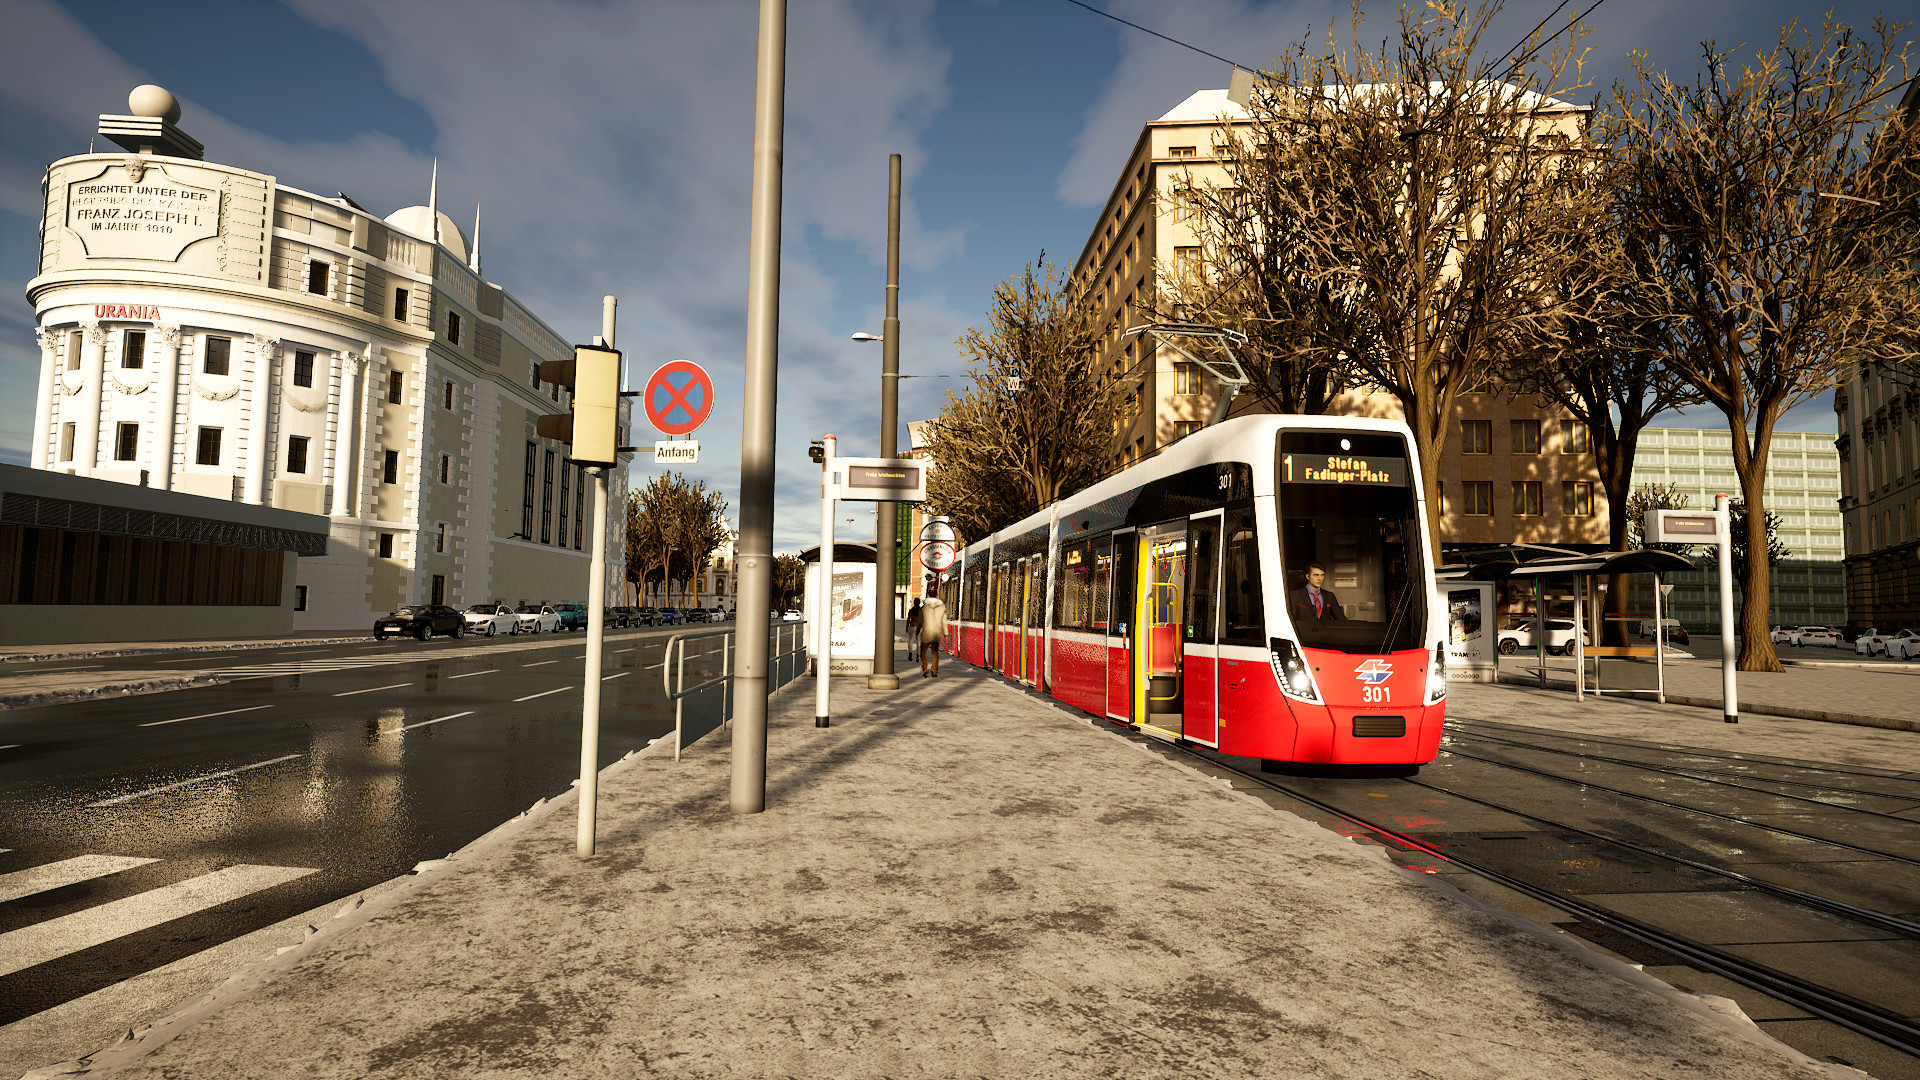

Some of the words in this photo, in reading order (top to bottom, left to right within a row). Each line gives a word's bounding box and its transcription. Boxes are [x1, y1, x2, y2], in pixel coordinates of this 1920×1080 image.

[78, 185, 133, 195] ERRICHTET
[137, 186, 177, 197] UNTER
[181, 190, 208, 202] DER
[132, 197, 155, 205] DES
[77, 208, 120, 220] FRANZ
[124, 209, 188, 225] JOSEPH
[91, 222, 102, 231] IM
[104, 222, 142, 232] JAHRE
[146, 224, 173, 234] 1910
[94, 304, 161, 320] URANIA
[657, 446, 695, 459] Anfang
[1283, 454, 1293, 482] 1
[1327, 456, 1367, 470] Stefan
[1218, 472, 1232, 490] 301
[1305, 467, 1390, 483] Fadinger-Platz
[1362, 685, 1391, 703] 301
